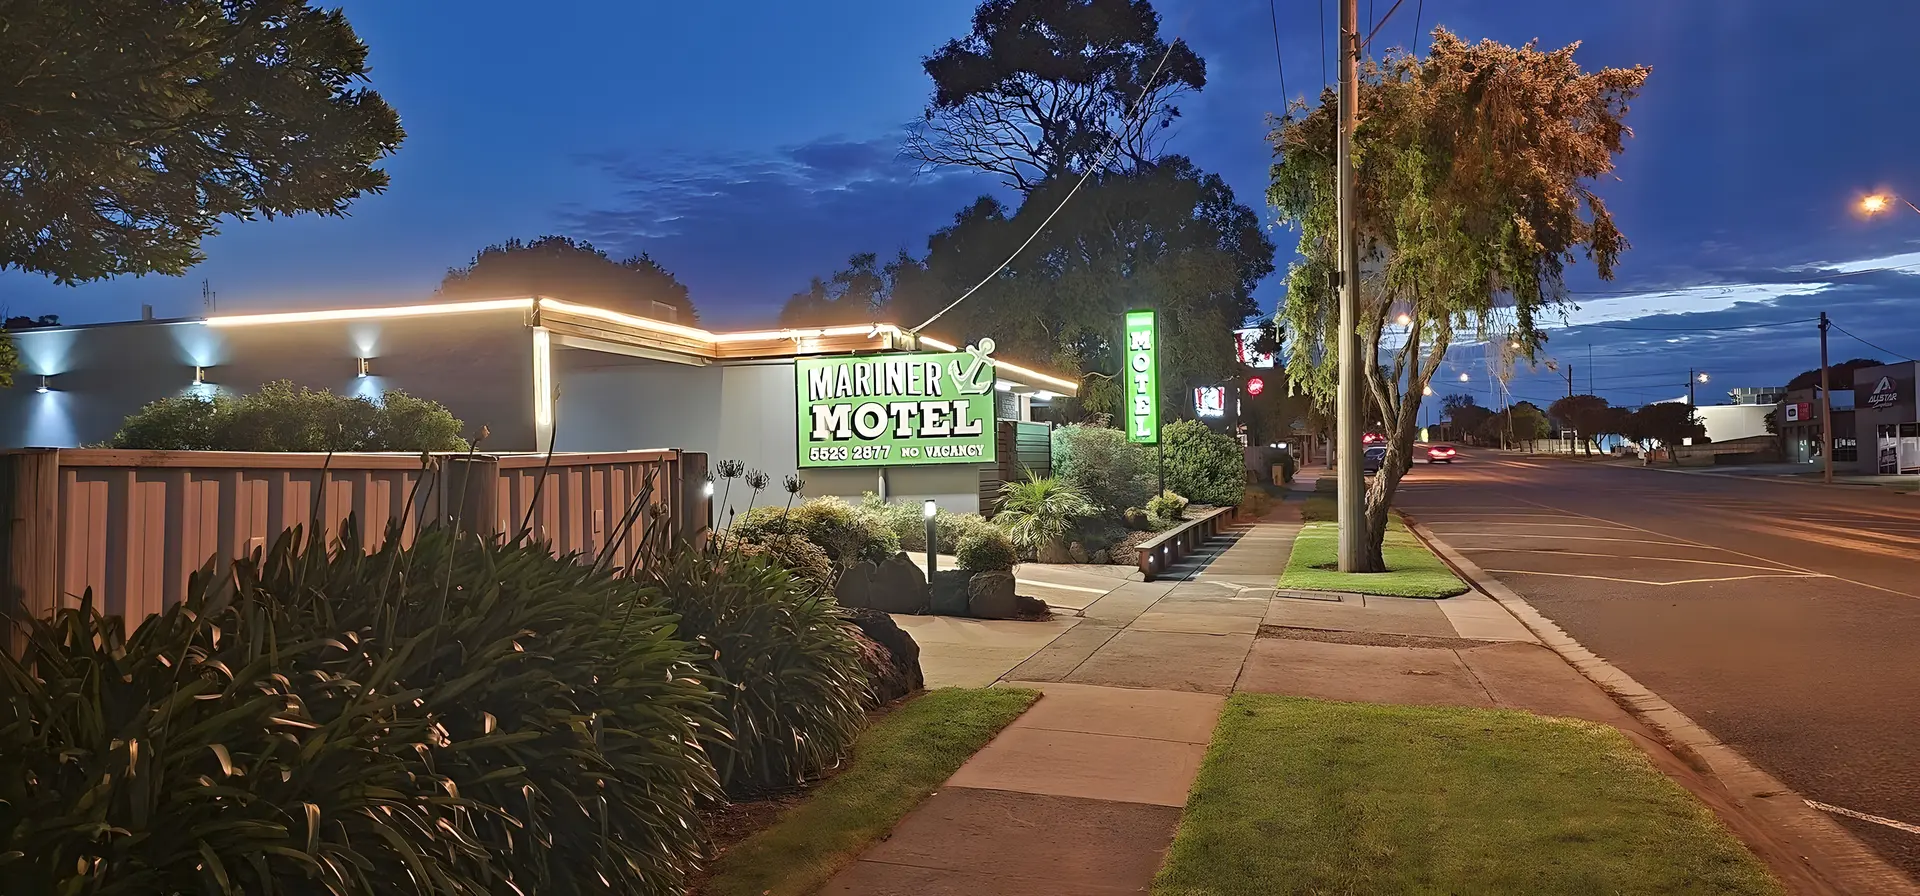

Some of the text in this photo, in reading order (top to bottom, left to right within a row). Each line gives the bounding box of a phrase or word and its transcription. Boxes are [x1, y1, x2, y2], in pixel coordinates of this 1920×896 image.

[808, 361, 942, 401] MARINER
[1130, 330, 1151, 438] MOTEL
[1868, 392, 1898, 403] ALLSTAR
[809, 399, 983, 441] MOTEL
[809, 444, 985, 461] 5523 2877 NO VACANCY
